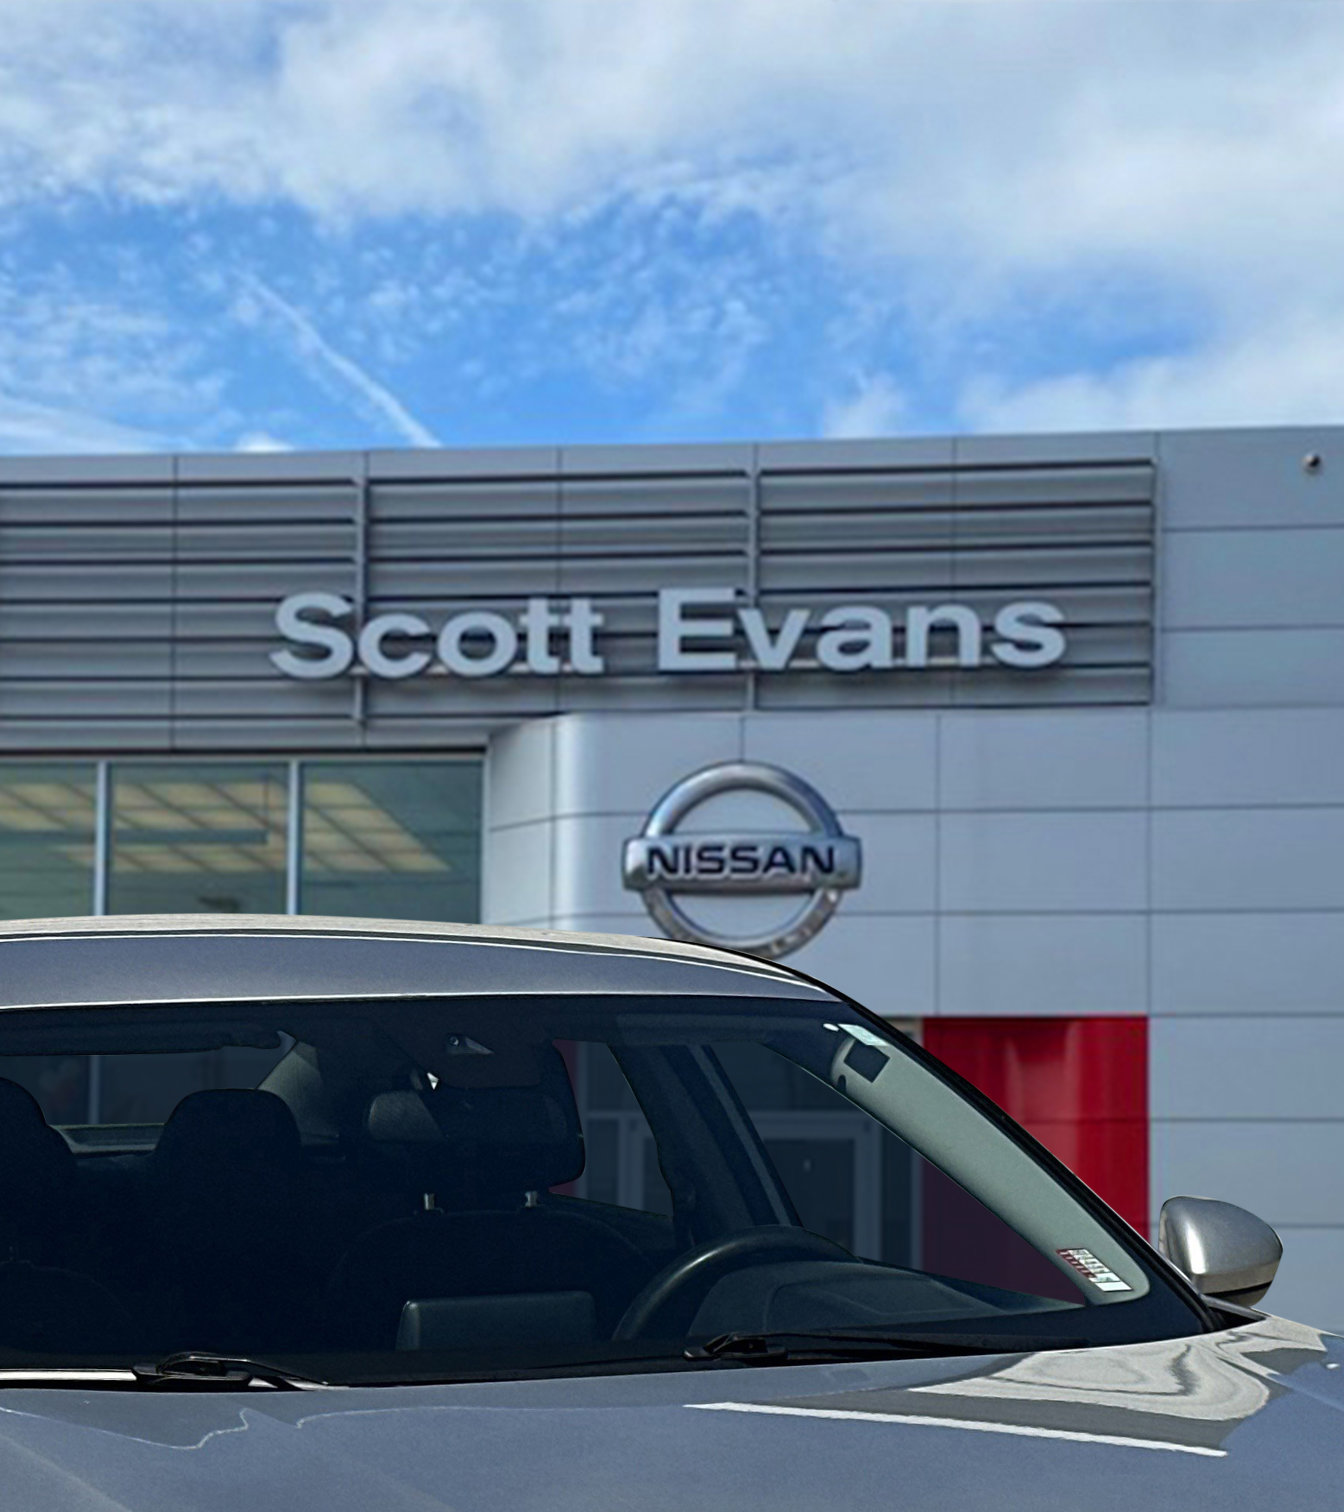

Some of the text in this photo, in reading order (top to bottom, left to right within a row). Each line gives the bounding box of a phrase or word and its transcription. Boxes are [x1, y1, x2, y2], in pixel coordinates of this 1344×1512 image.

[269, 587, 1067, 678] Scott Evans
[647, 845, 834, 875] NISSAN
